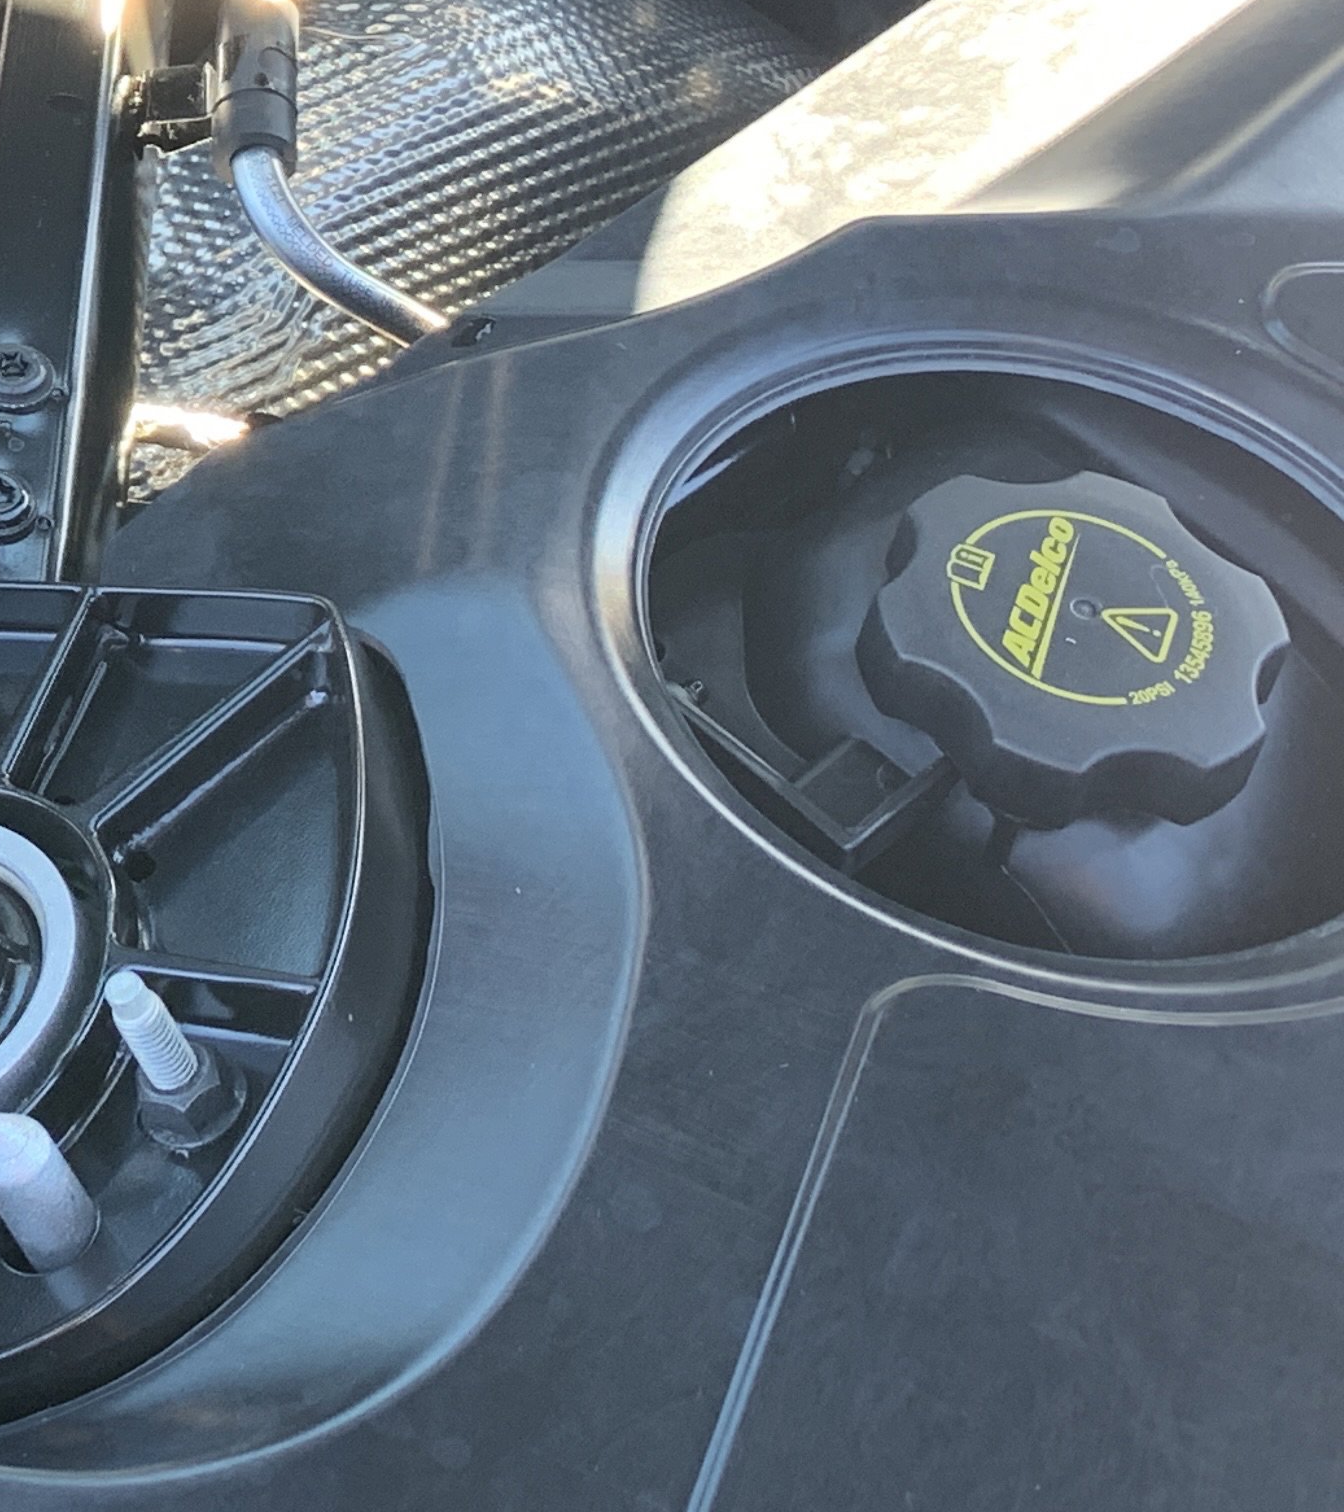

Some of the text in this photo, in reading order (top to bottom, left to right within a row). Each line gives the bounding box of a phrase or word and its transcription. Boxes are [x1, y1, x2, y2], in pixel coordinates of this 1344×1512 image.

[1002, 516, 1076, 668] ACDelco
[1128, 680, 1176, 705] 20PSI
[1174, 610, 1213, 684] 13545896
